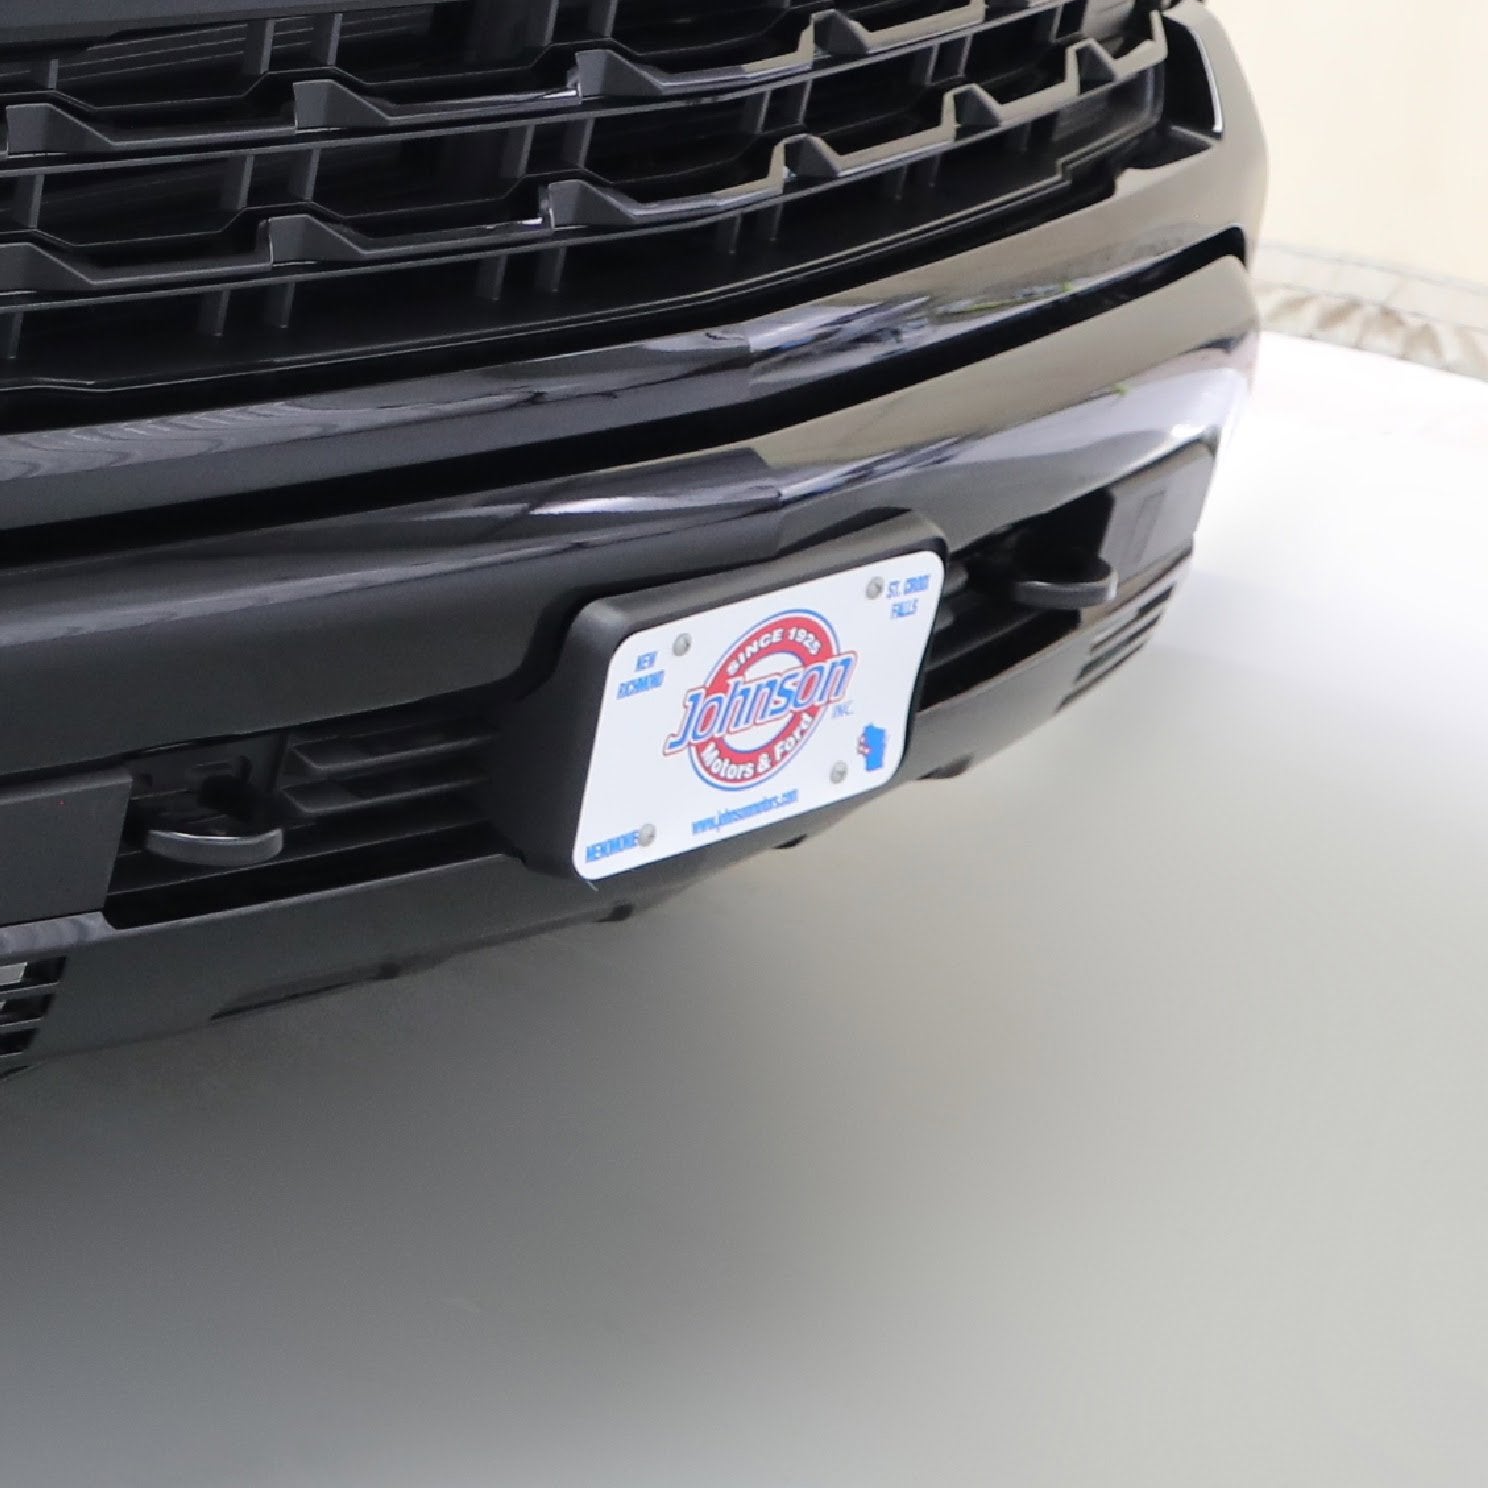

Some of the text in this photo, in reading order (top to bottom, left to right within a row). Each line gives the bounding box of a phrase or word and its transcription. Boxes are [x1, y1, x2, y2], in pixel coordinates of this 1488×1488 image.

[727, 627, 785, 676] SINCE
[665, 650, 857, 754] Johnson
[702, 712, 814, 780] Motors & Ford
